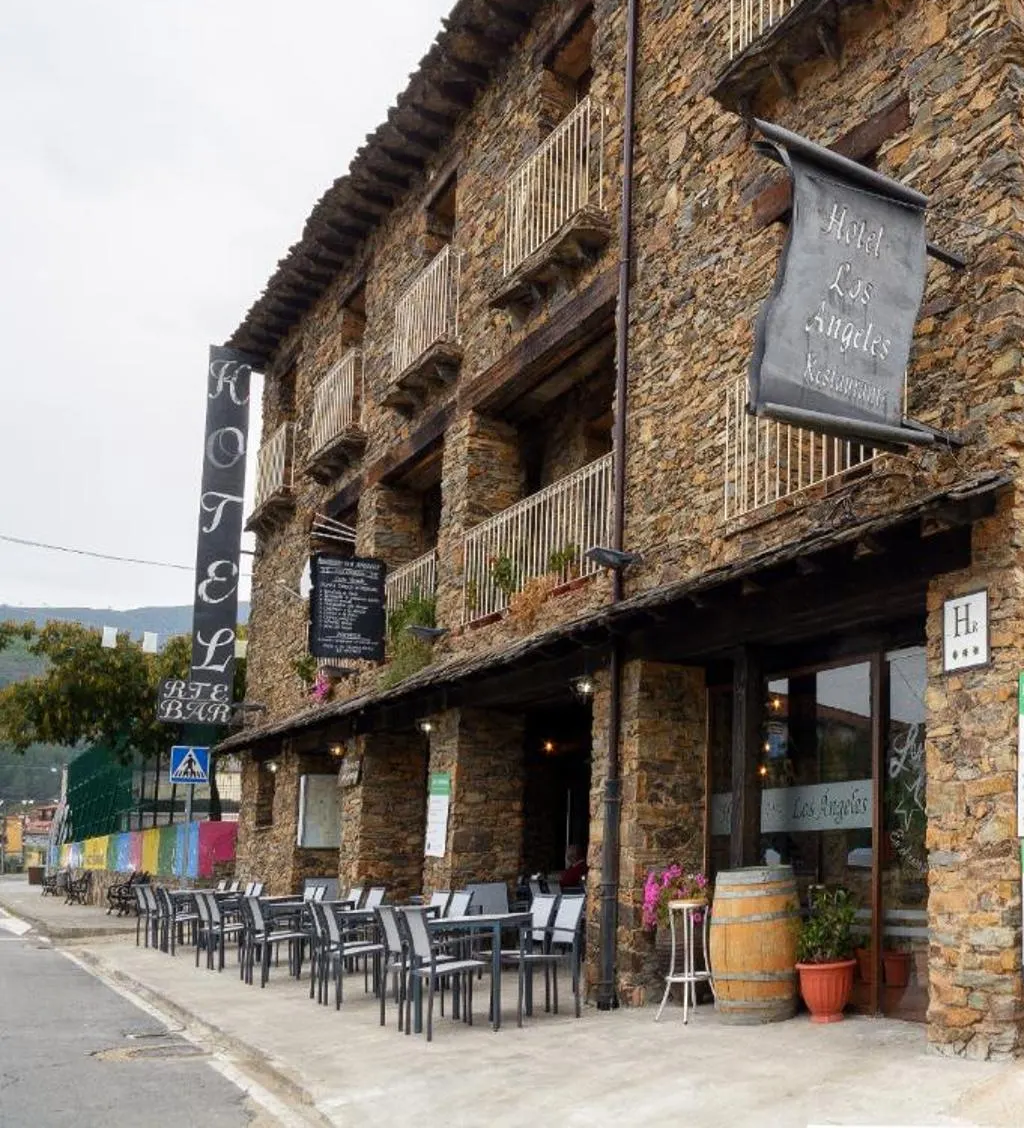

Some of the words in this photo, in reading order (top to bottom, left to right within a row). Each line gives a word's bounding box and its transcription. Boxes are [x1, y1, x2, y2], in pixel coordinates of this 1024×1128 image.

[822, 203, 884, 258] Hotel
[829, 261, 873, 305] Los
[191, 359, 251, 673] HOTEL
[159, 699, 231, 722] BAR
[163, 680, 230, 702] RTE
